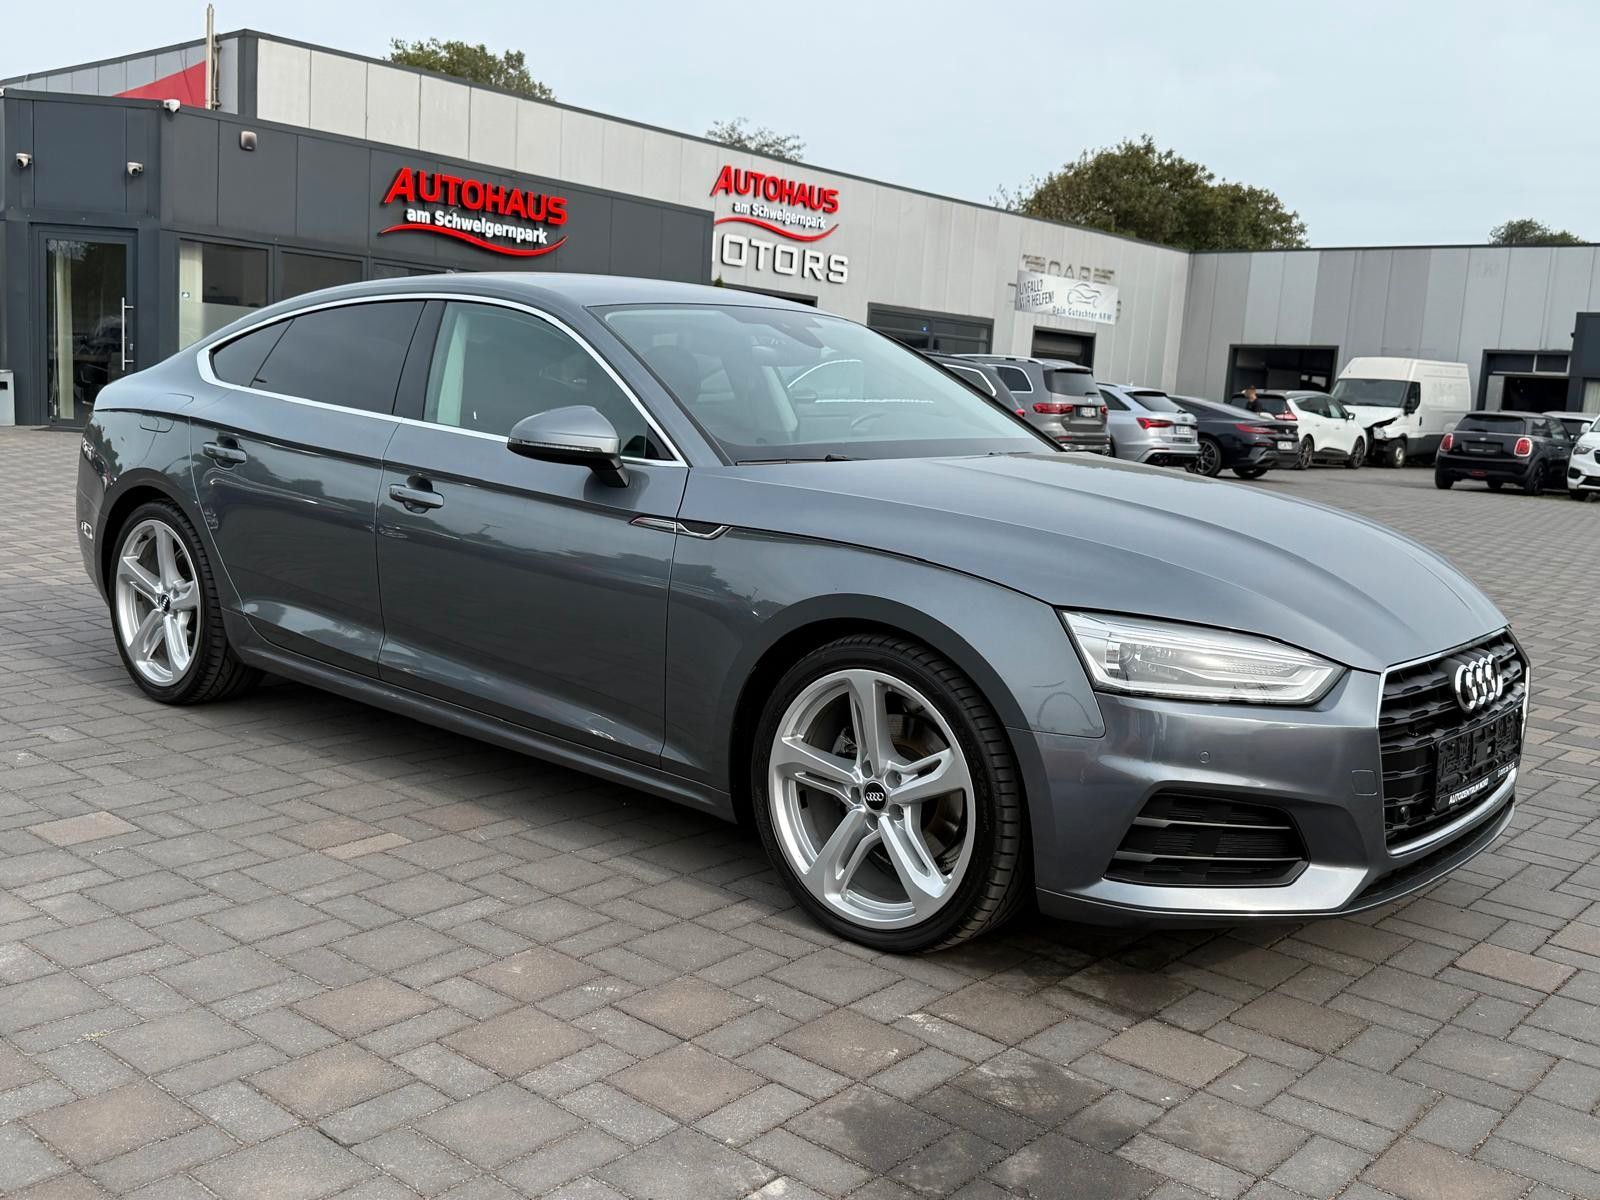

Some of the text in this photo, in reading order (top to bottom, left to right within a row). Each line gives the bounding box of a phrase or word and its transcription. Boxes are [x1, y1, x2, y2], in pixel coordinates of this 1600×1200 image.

[384, 167, 568, 226] AUTOHAUS
[710, 165, 839, 214] AUTOHAUS
[734, 201, 750, 215] am
[406, 208, 548, 245] am Schwelgernpark
[712, 231, 849, 284] OTORS
